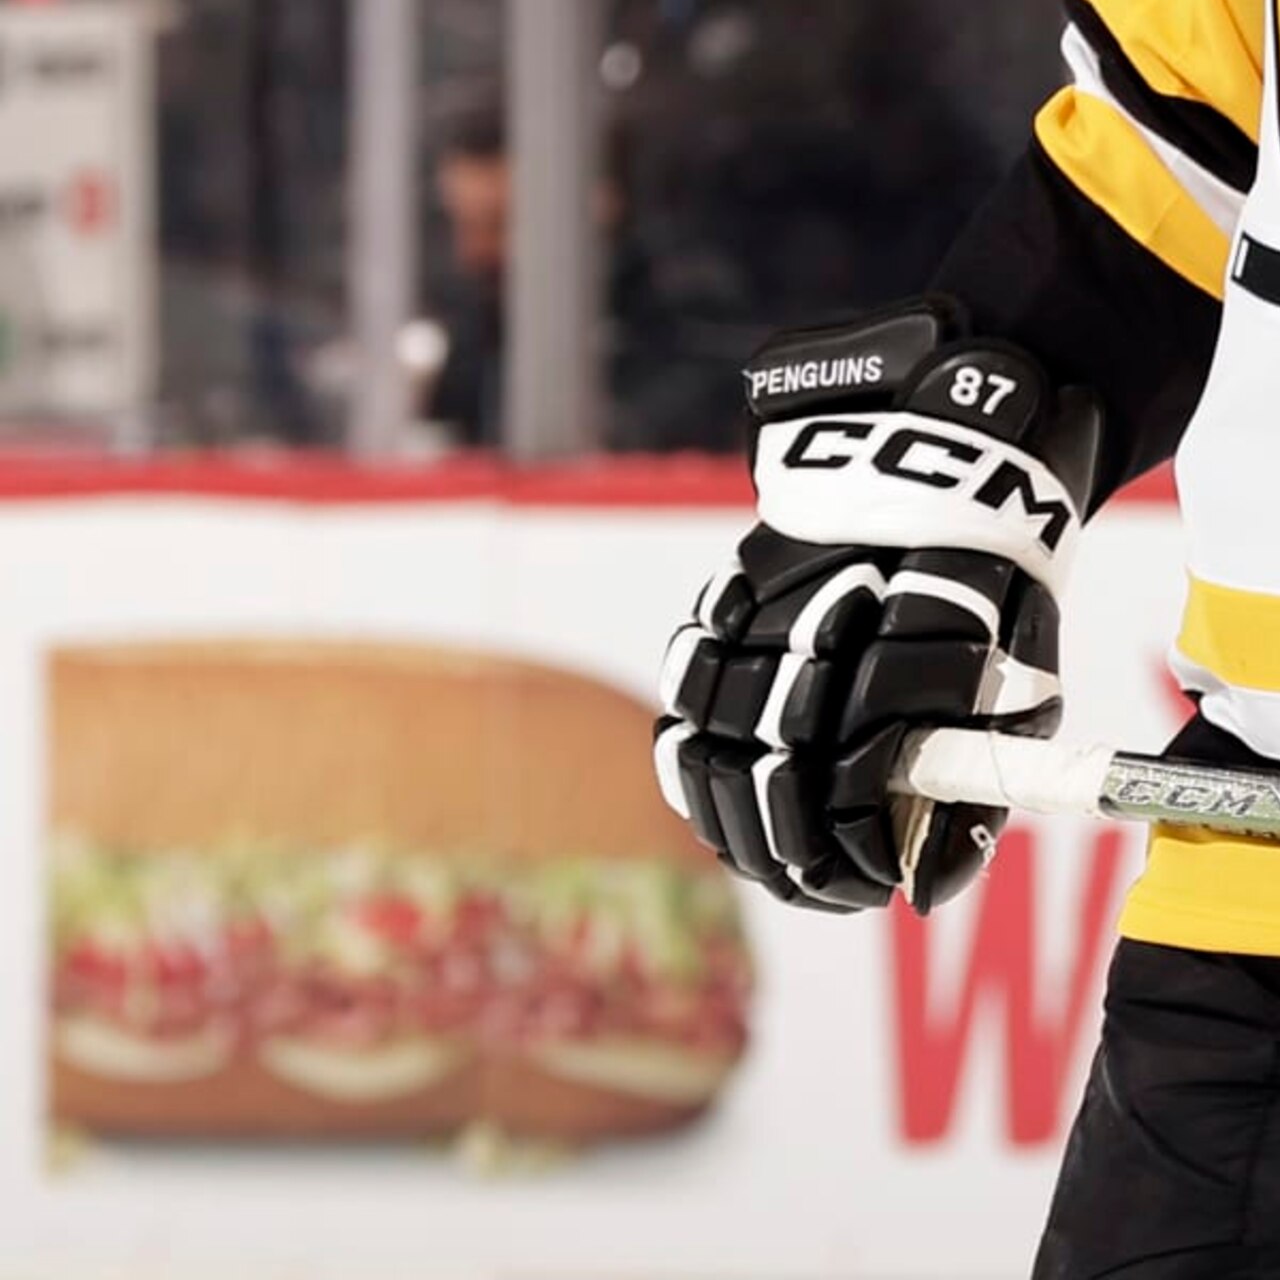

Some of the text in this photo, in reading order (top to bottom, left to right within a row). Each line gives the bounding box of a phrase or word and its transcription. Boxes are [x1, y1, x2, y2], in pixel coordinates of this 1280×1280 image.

[750, 355, 883, 399] PENGUINS
[949, 366, 1017, 415] 87
[781, 421, 1071, 552] CCM
[1117, 778, 1259, 817] CCM
